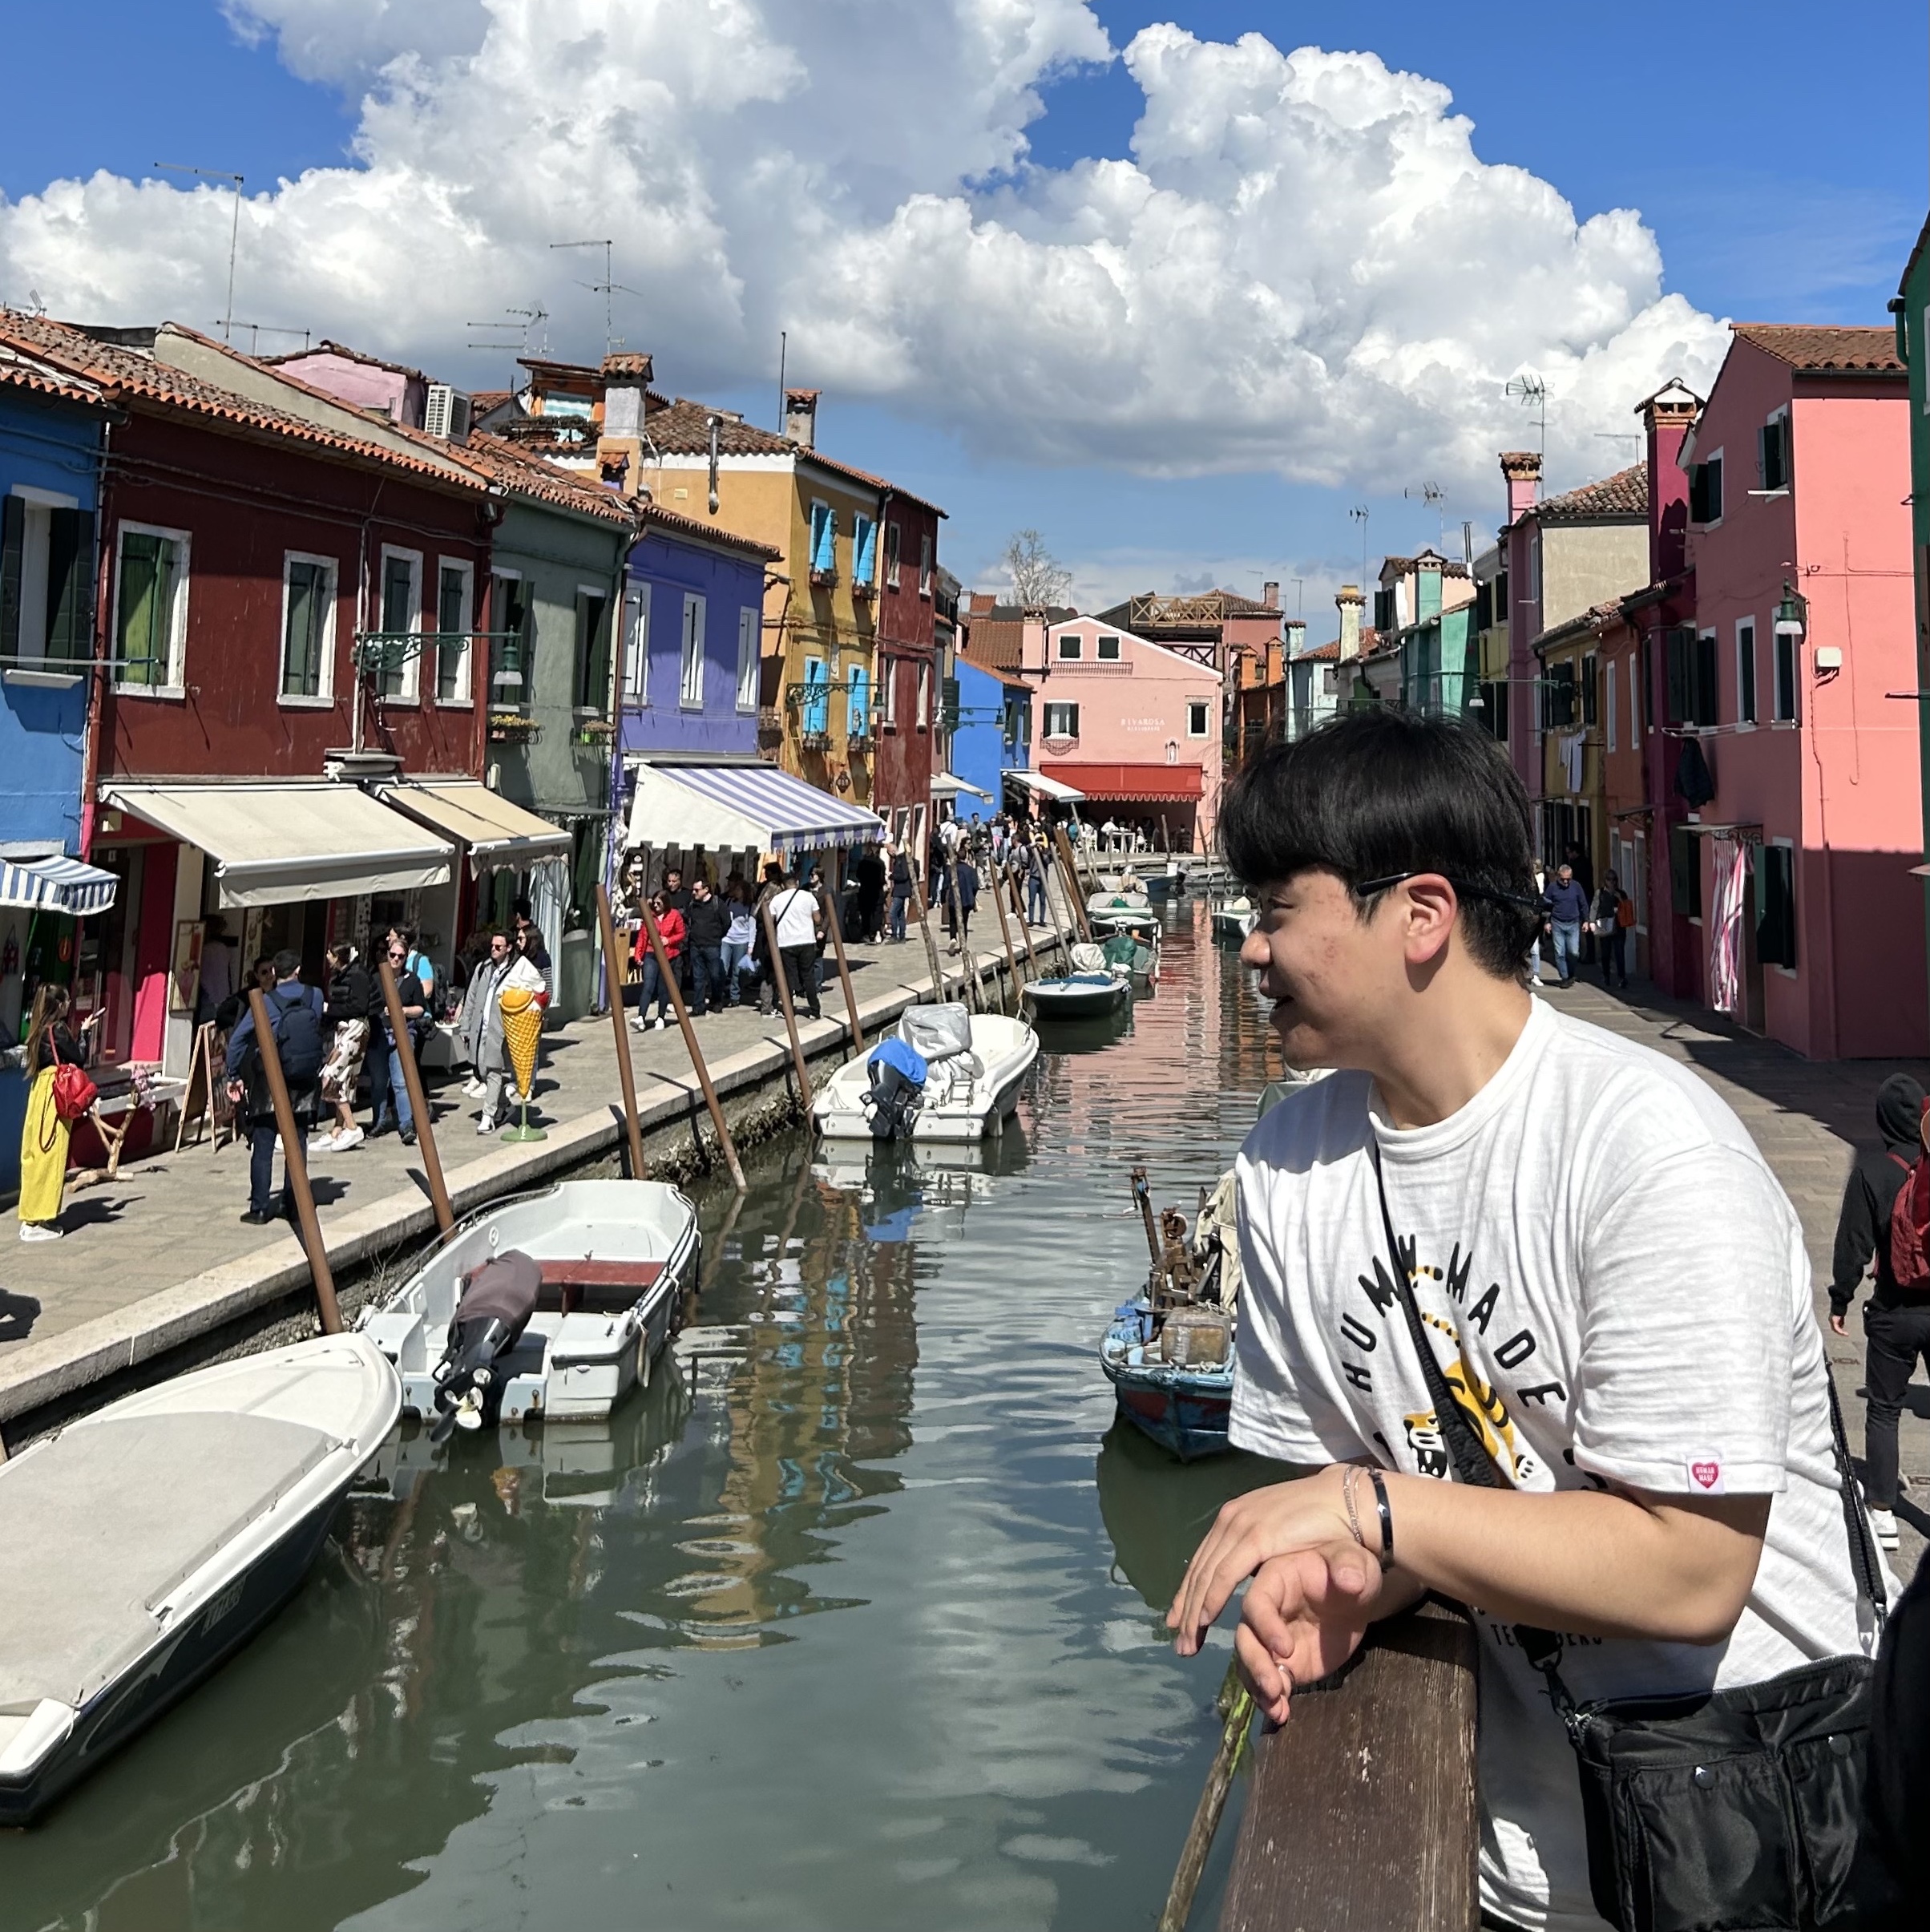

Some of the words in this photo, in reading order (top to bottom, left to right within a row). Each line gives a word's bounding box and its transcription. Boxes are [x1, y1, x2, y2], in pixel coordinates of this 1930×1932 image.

[1120, 717, 1165, 726] RIVAROSA
[1340, 1233, 1417, 1393] HUMN
[1446, 1241, 1567, 1409] MADE
